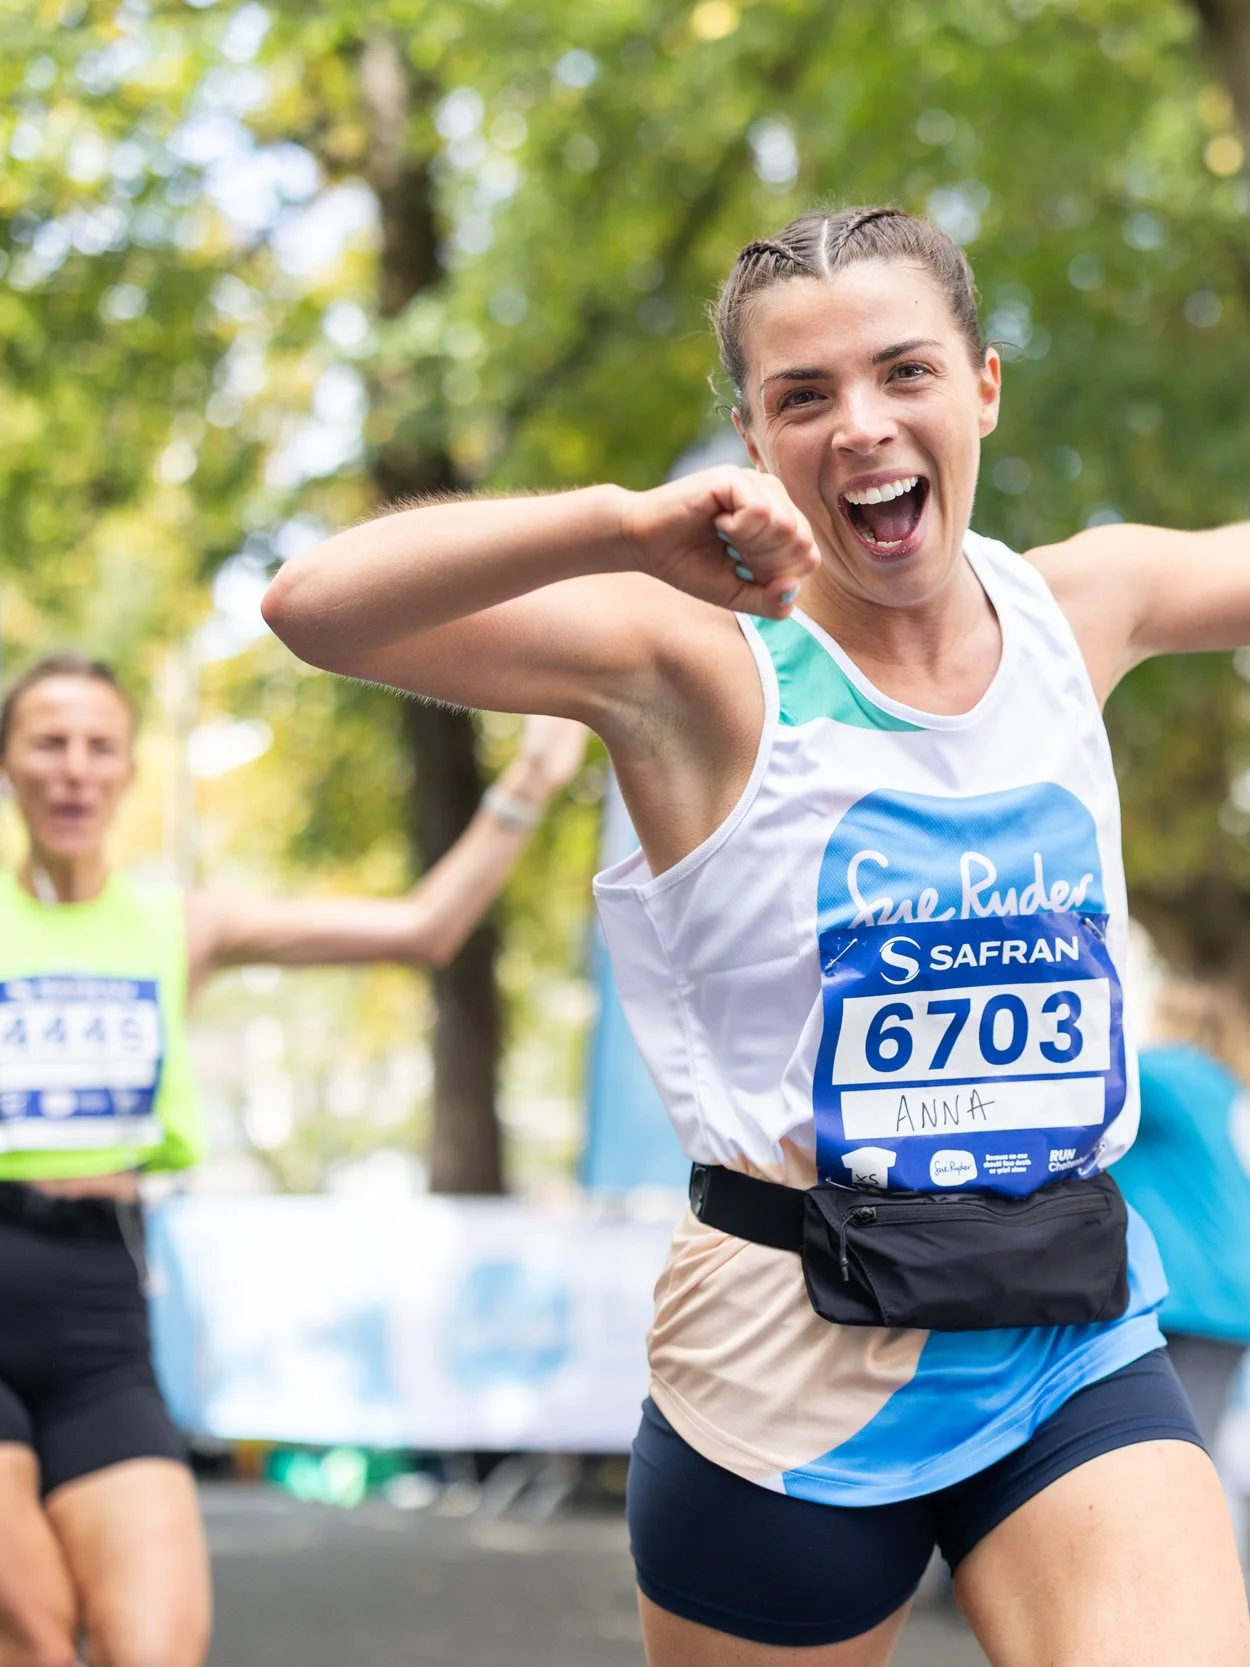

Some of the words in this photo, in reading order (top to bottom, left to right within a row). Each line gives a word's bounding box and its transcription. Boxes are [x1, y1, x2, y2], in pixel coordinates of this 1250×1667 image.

[929, 936, 1079, 971] SAFRAN
[865, 990, 1084, 1073] 6703
[896, 1089, 995, 1132] ANNA
[1049, 1148, 1076, 1162] RUN
[855, 1173, 879, 1186] XS
[934, 1161, 950, 1177] Sue
